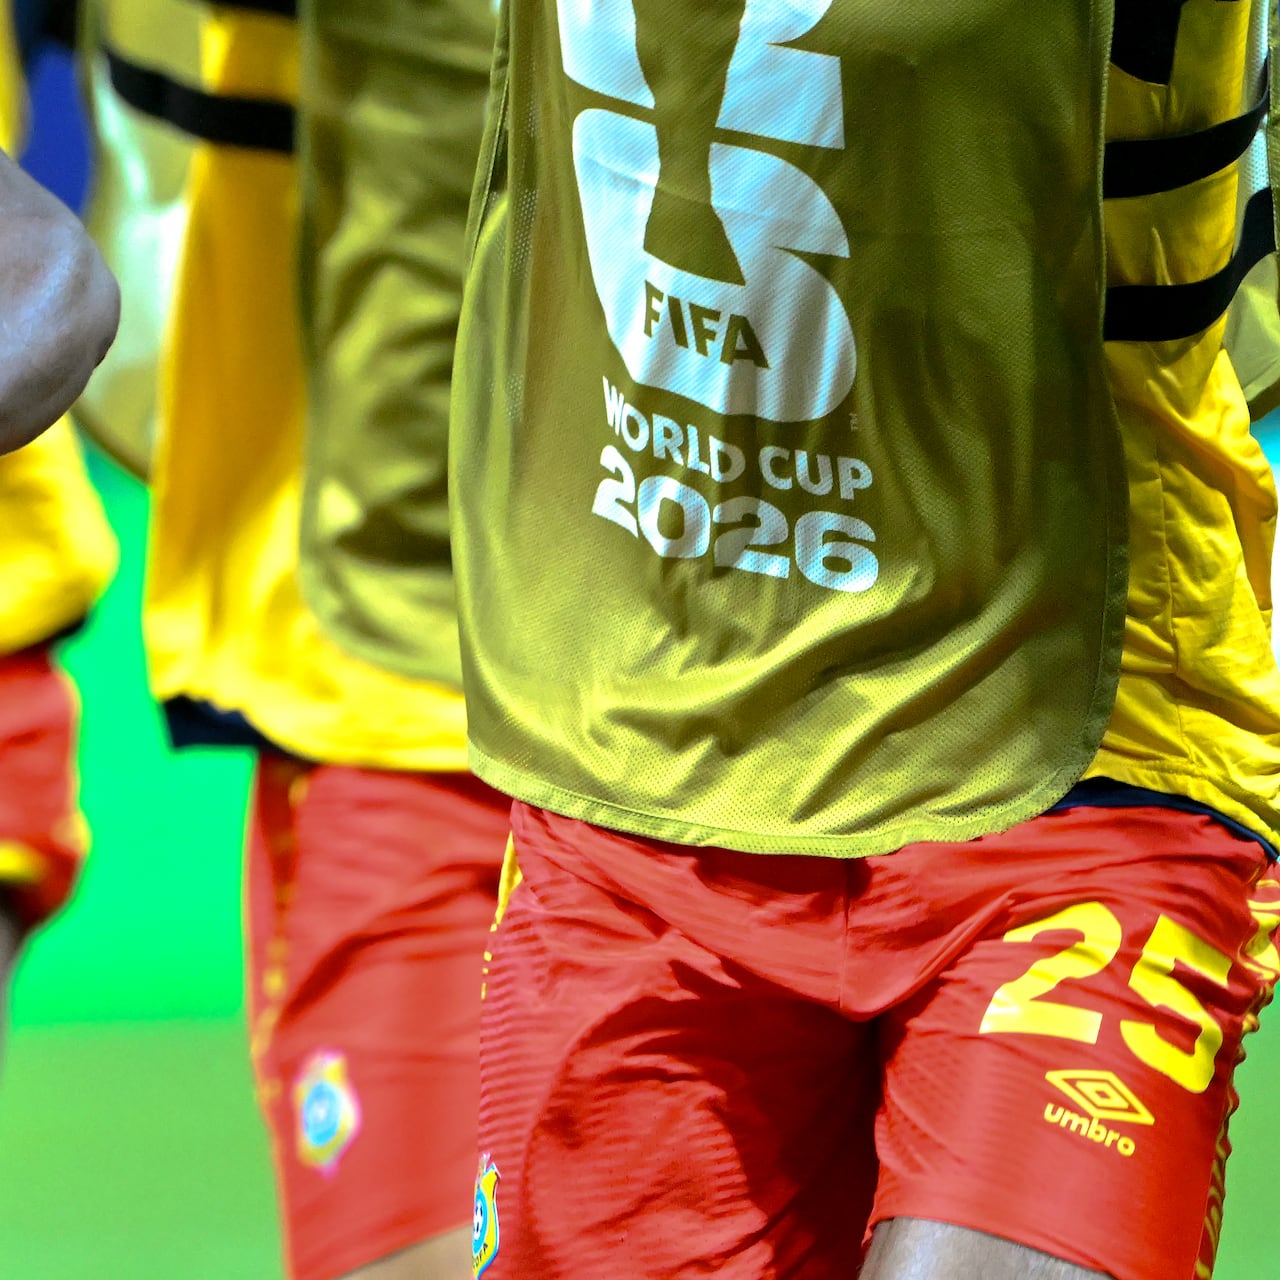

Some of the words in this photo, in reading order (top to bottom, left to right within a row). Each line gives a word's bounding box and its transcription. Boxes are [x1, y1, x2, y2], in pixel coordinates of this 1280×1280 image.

[643, 279, 772, 369] FIFA
[602, 375, 746, 483] WORLD
[758, 445, 873, 500] CUP
[591, 444, 879, 593] 2026
[979, 901, 1233, 1093] 25
[1043, 1102, 1136, 1157] umbro
